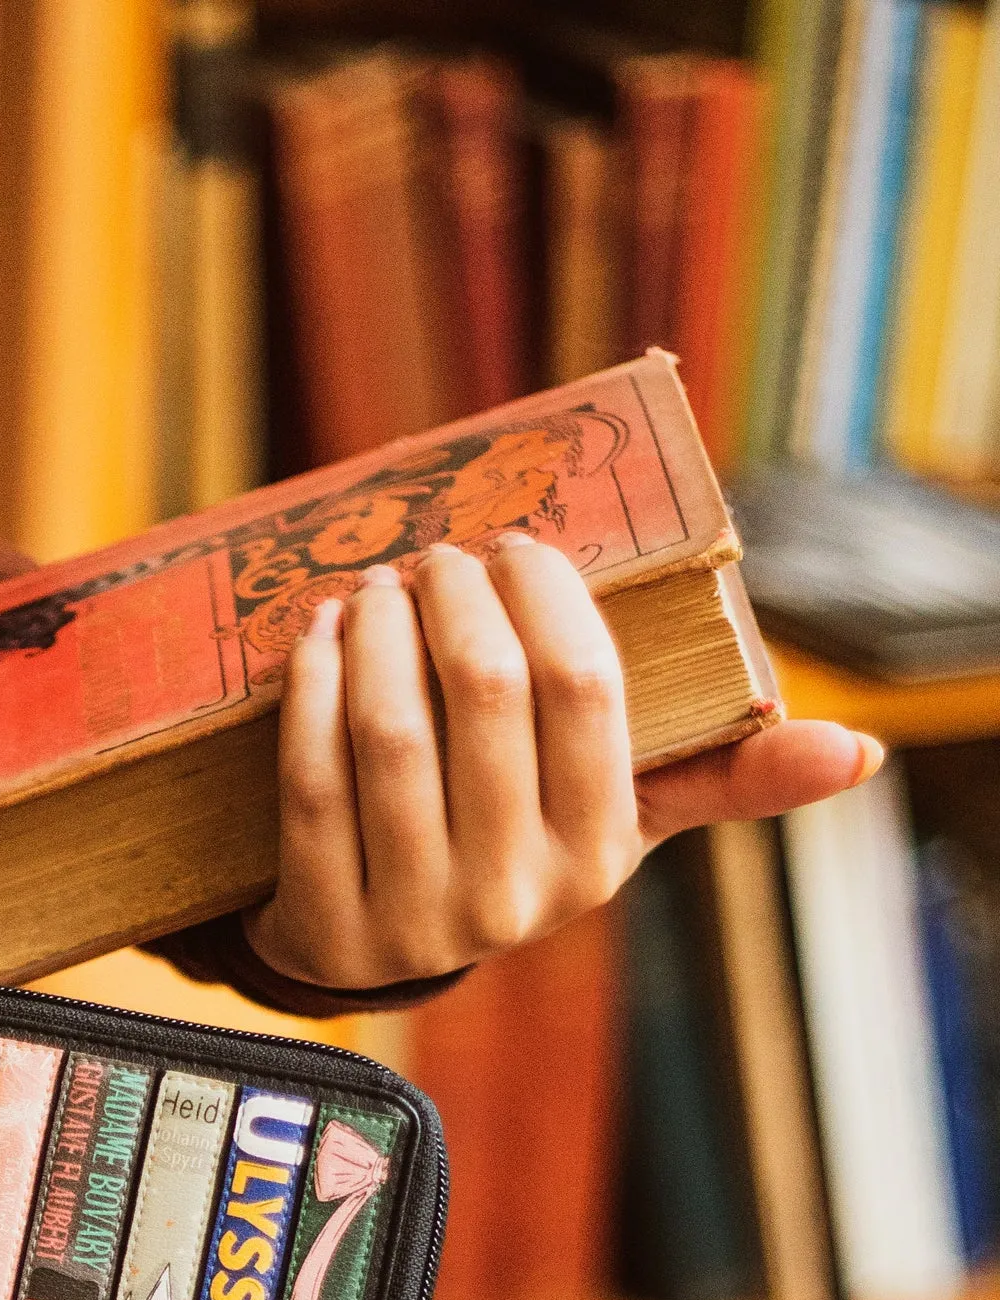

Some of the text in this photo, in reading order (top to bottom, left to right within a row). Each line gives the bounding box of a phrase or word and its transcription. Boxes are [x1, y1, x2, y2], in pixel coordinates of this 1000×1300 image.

[36, 1063, 102, 1263] GUSTAVE FLAUBERT
[72, 1067, 149, 1272] MADAME BOVARY
